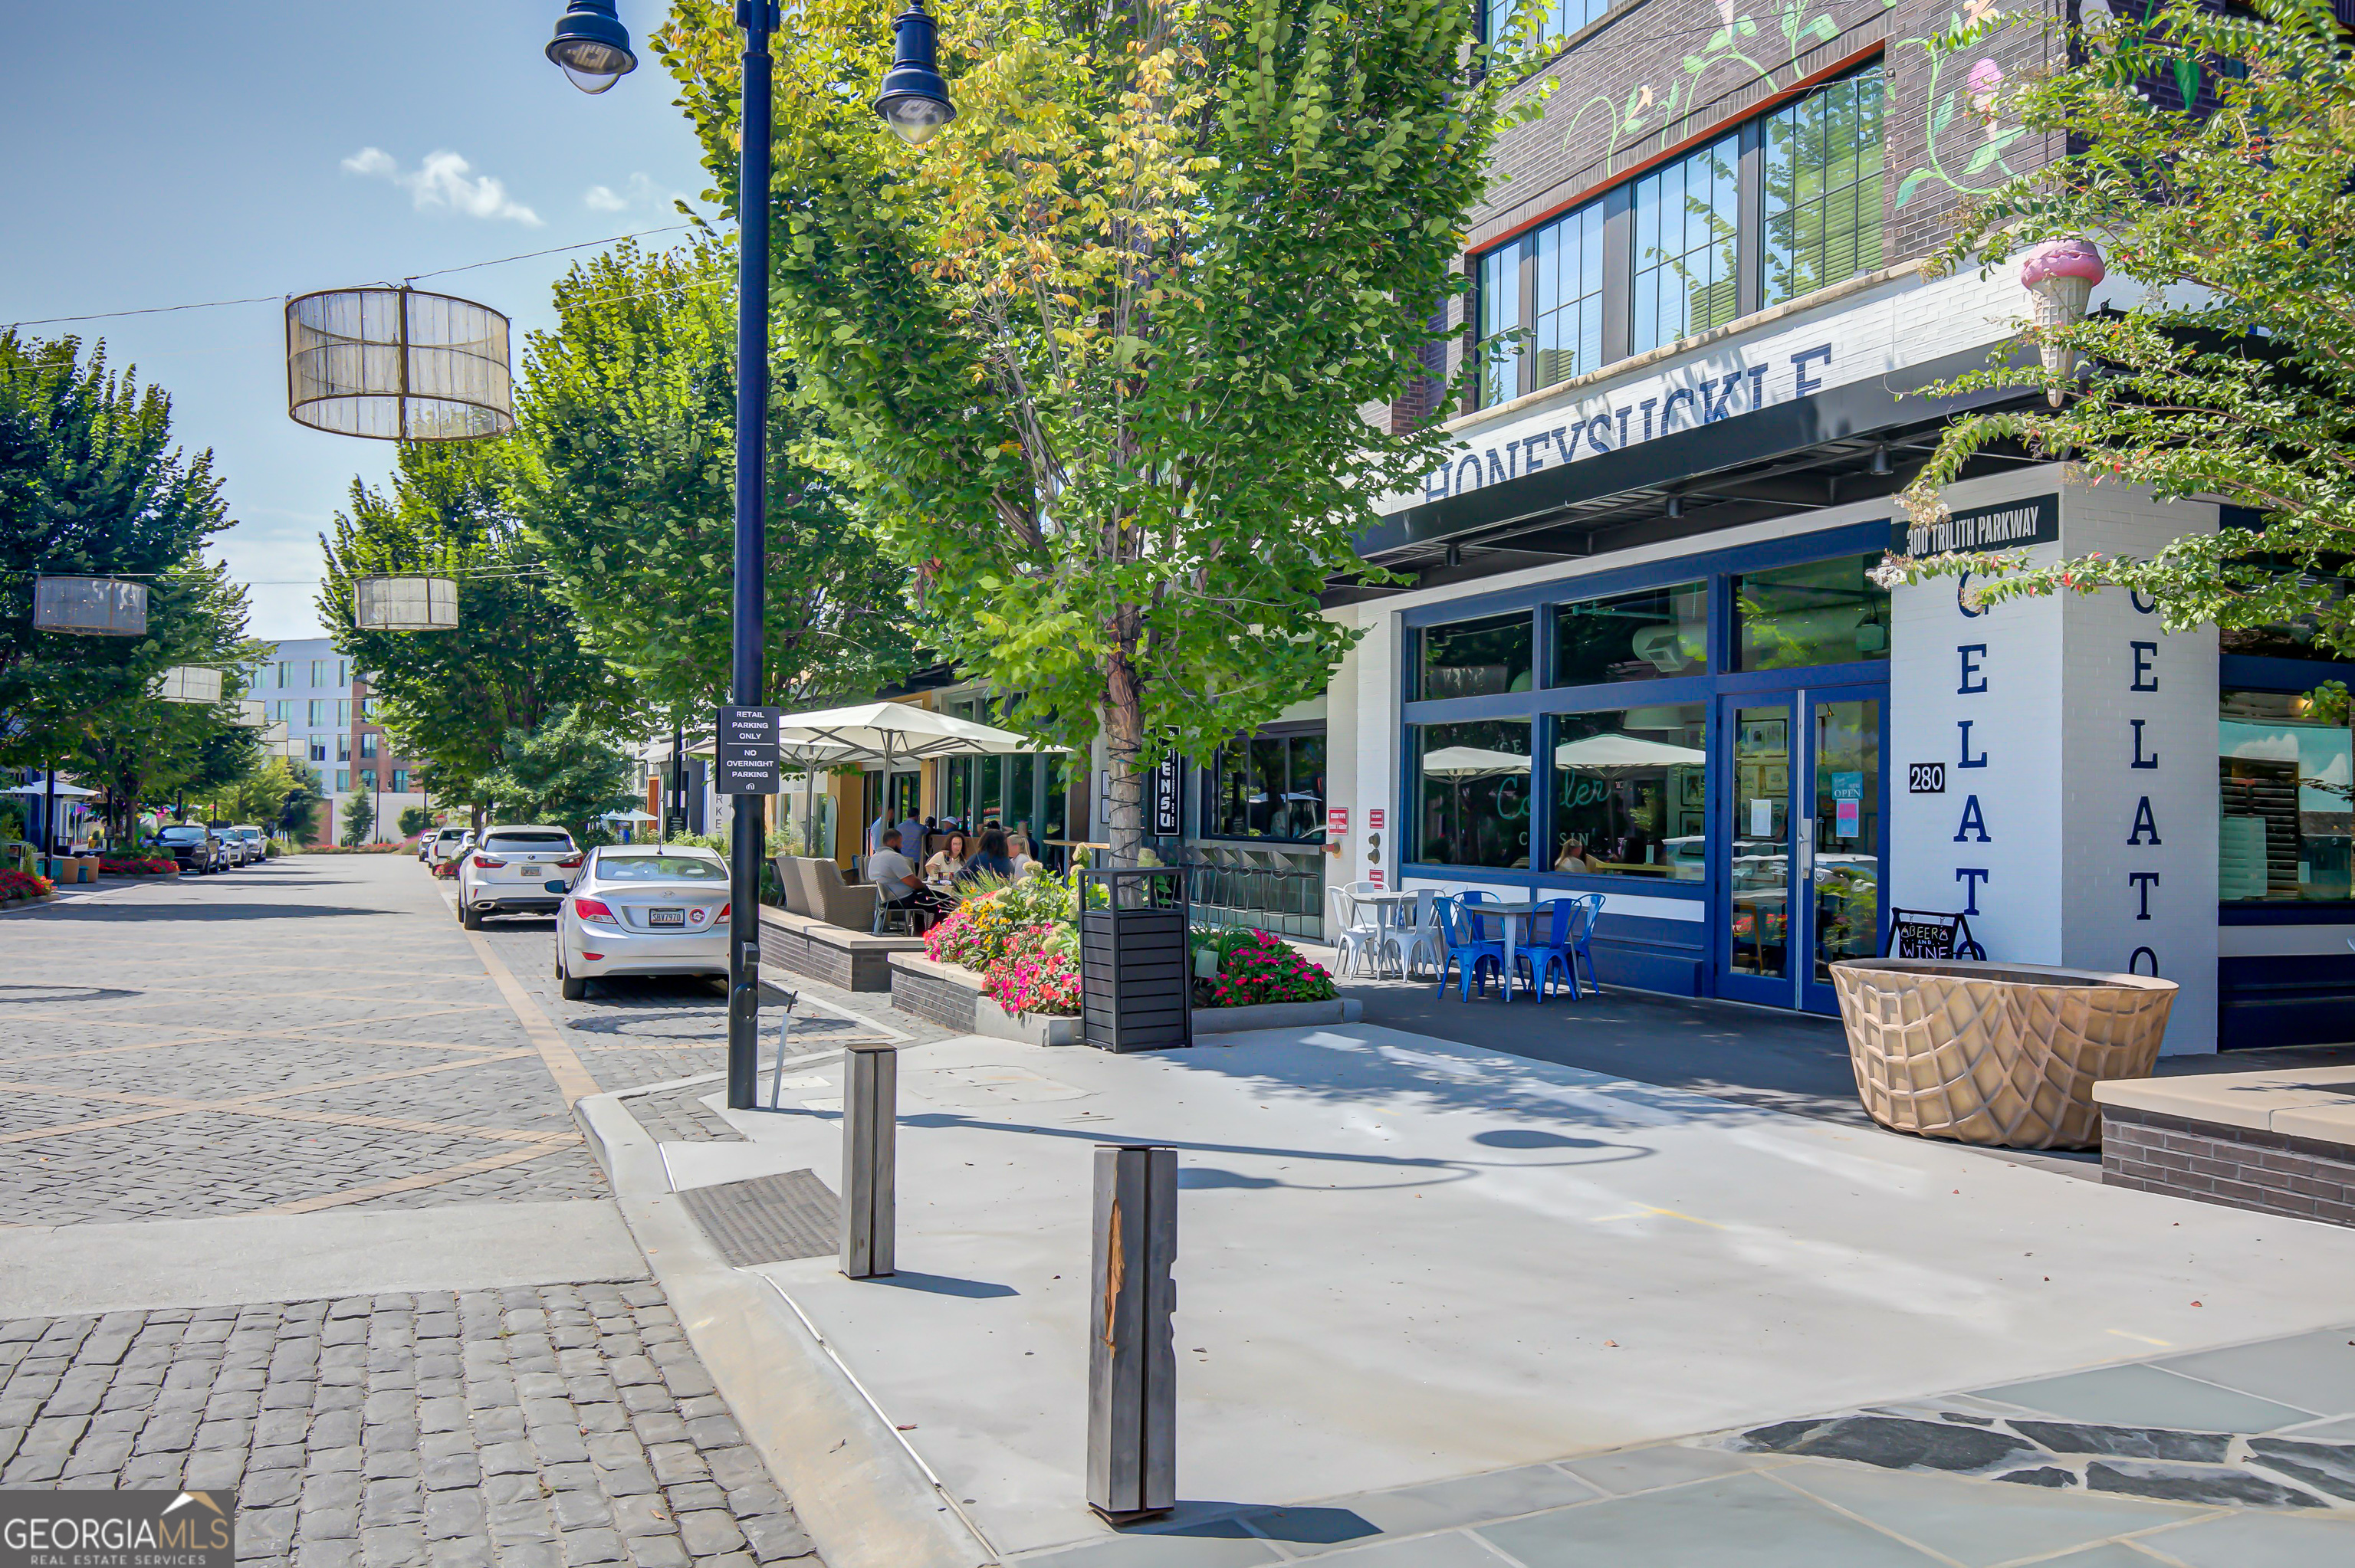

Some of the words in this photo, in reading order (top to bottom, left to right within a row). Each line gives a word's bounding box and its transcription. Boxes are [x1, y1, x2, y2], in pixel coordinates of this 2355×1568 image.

[1426, 343, 1831, 503] HONEYSUCKLE
[1907, 526, 1928, 556] 300
[1931, 517, 1974, 552] TRILITH
[1978, 506, 2038, 544] PARKWAY
[1490, 739, 1522, 754] CE
[1911, 766, 1943, 790] 280
[1497, 768, 1611, 820] Coler
[1834, 789, 1861, 797] OPEN
[1519, 832, 1589, 846] CSIN
[1909, 925, 1939, 940] BEER
[1903, 943, 1948, 960] WINE
